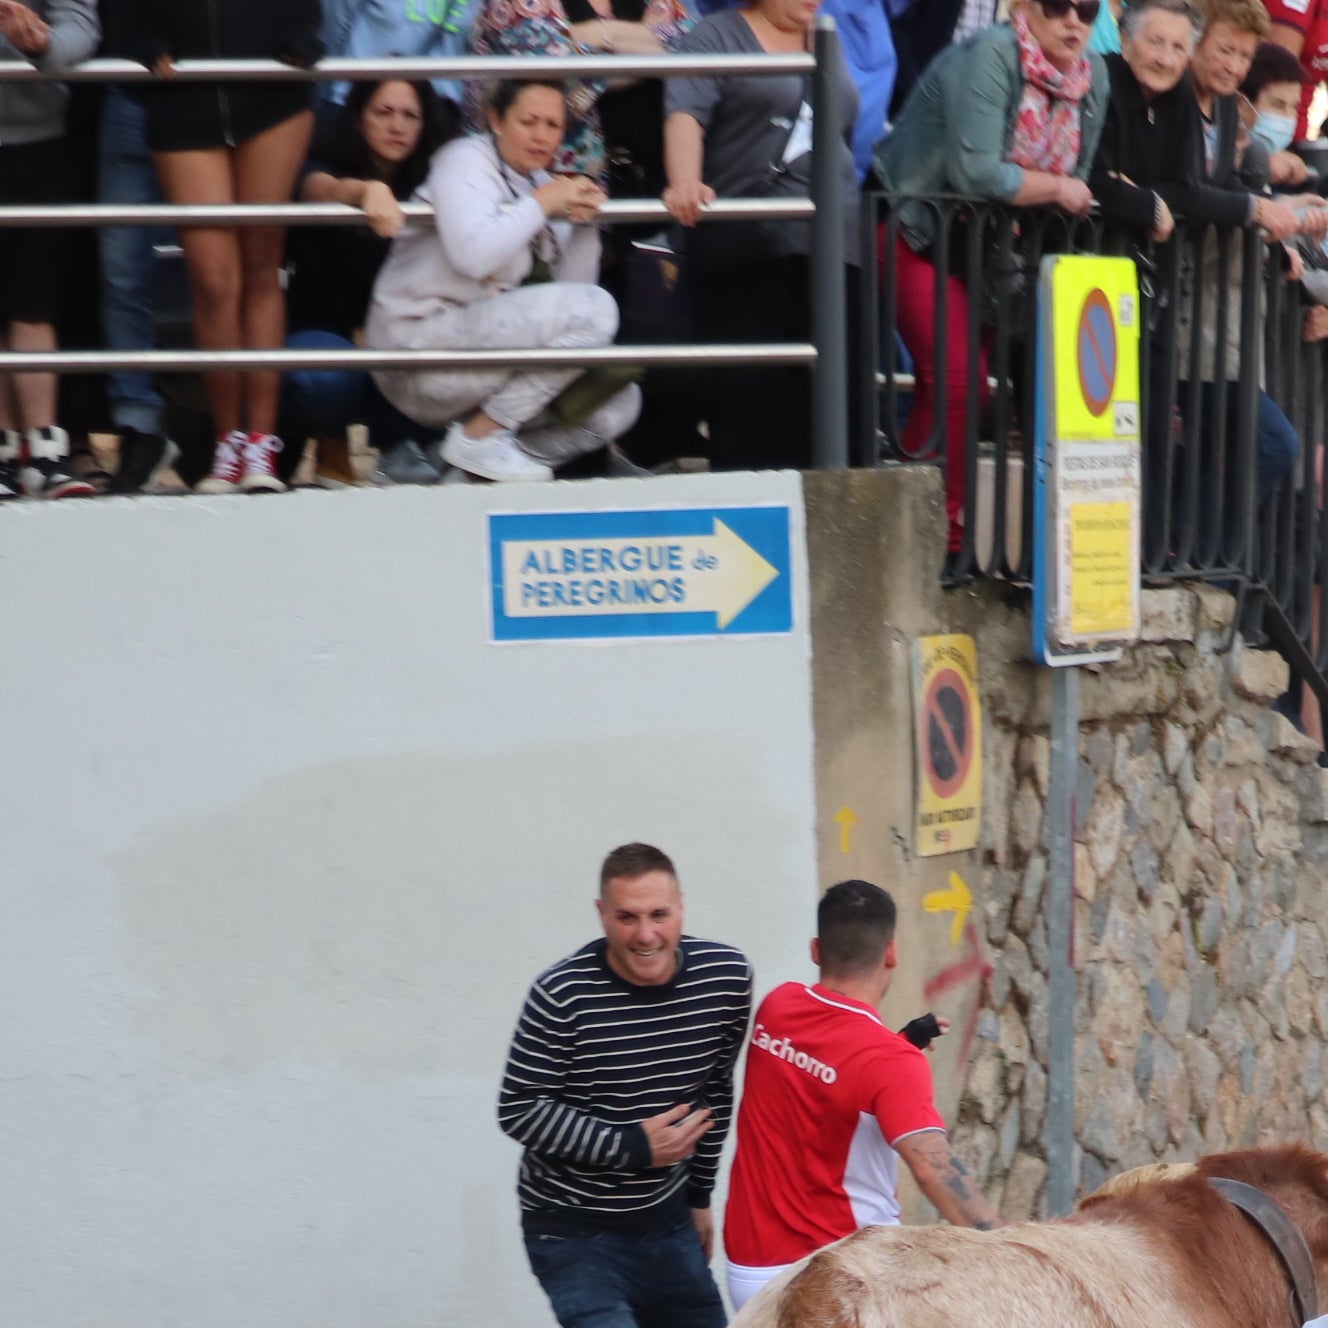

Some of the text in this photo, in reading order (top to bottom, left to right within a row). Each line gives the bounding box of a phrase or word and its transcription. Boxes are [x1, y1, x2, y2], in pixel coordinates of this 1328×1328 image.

[522, 545, 719, 575] ALBERGUE de
[522, 577, 685, 607] PEREGRINOS
[750, 1024, 838, 1085] Cachorro
